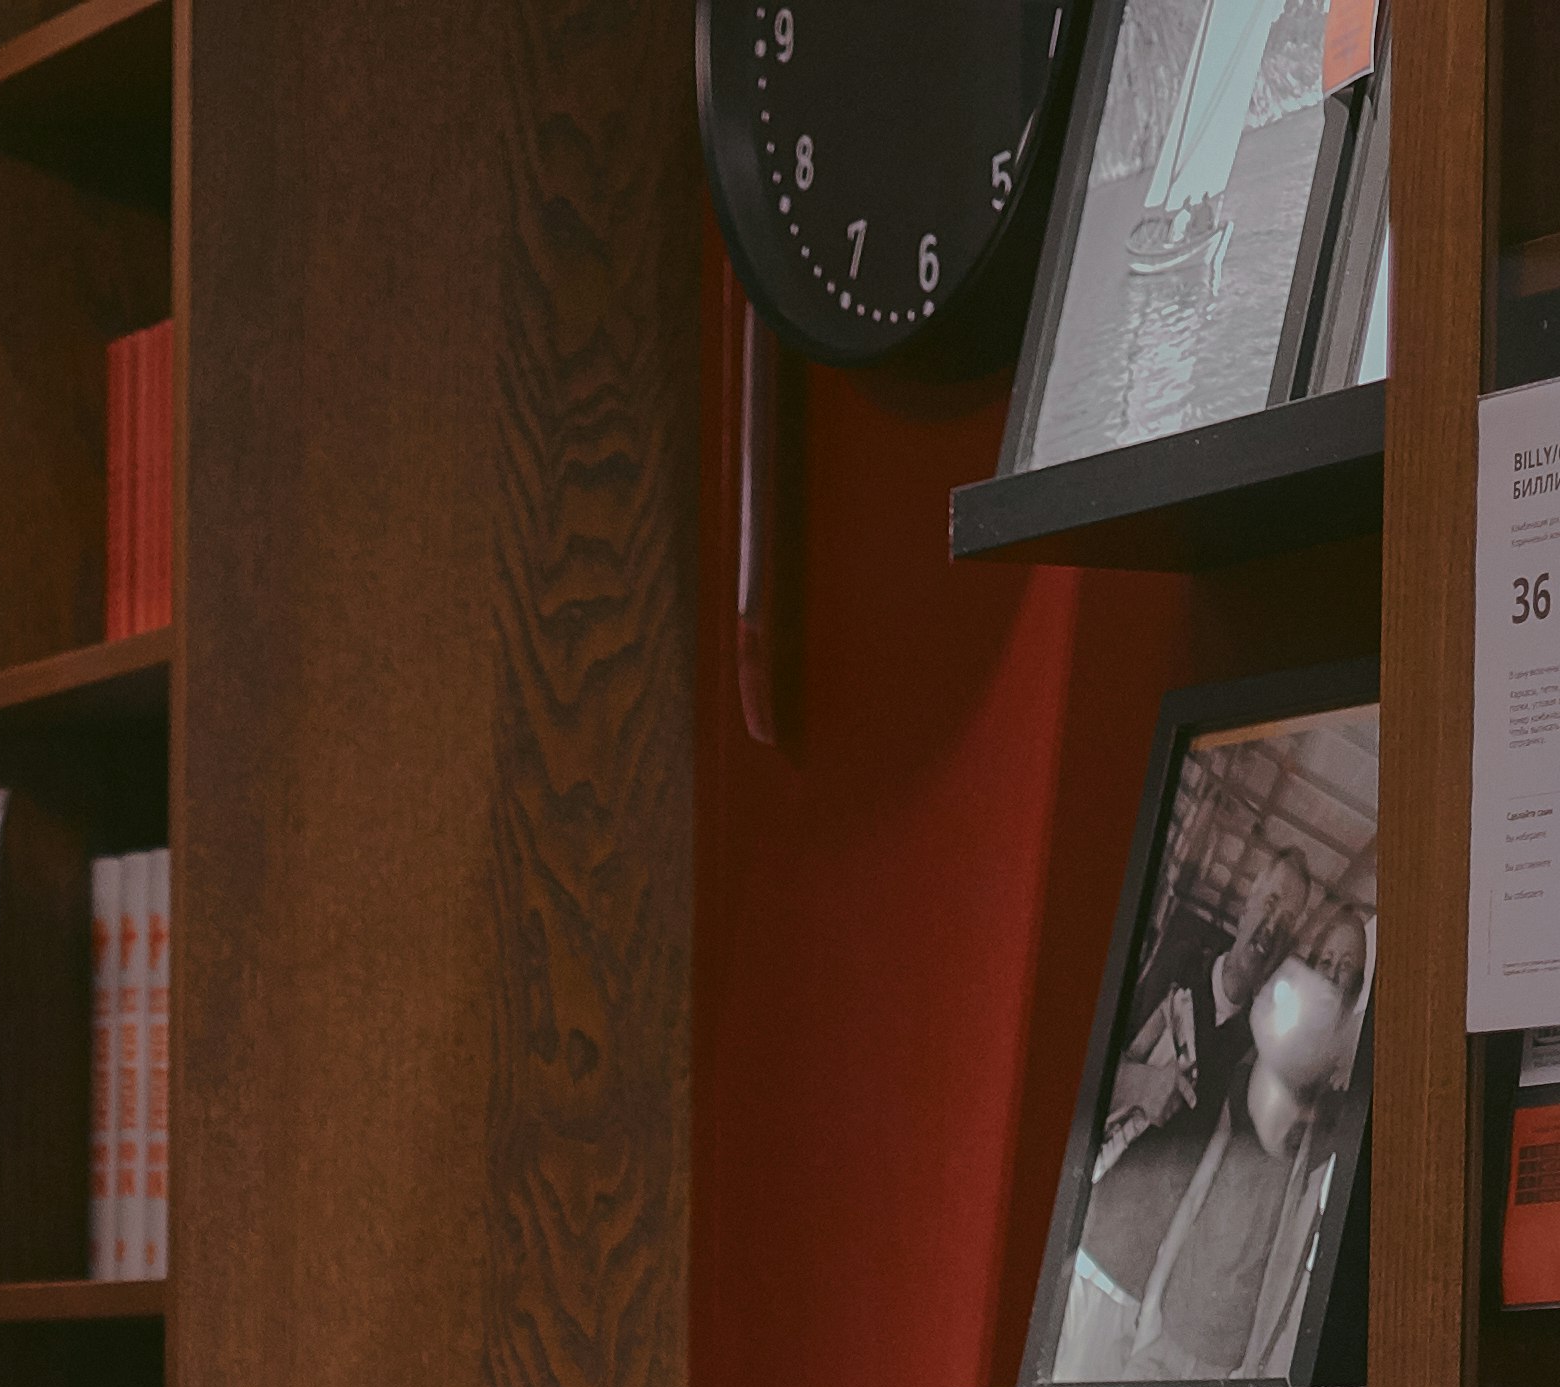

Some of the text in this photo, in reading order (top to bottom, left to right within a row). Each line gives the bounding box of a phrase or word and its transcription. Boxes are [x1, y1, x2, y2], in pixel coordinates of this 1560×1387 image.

[773, 7, 794, 63] 9
[795, 134, 815, 191] 8
[991, 150, 1013, 212] 5
[847, 219, 867, 280] 7
[918, 233, 940, 294] 6
[1511, 571, 1552, 625] 36
